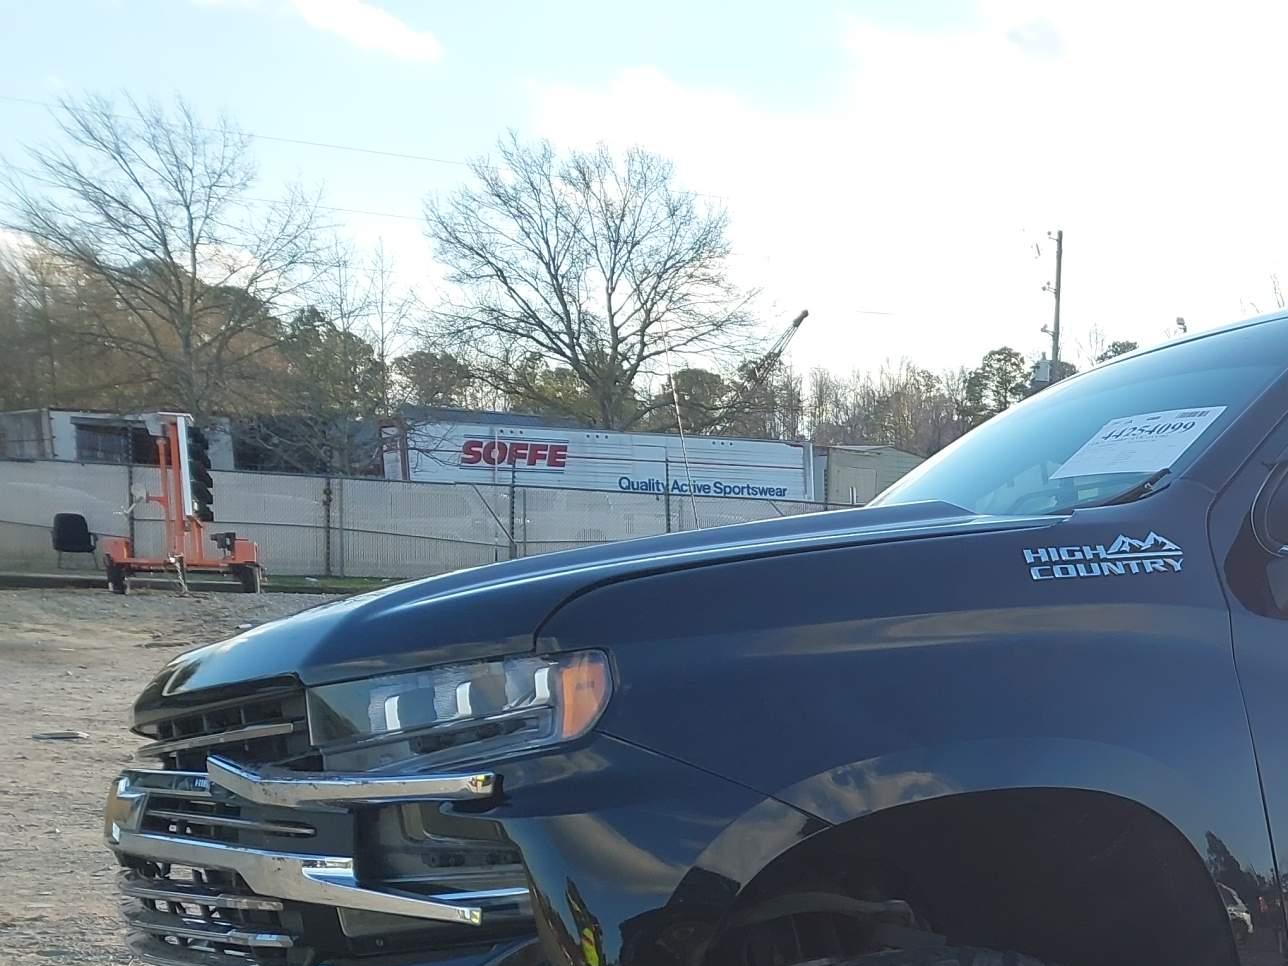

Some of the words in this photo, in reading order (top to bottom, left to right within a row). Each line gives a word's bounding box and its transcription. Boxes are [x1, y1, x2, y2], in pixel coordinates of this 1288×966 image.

[1101, 420, 1196, 440] 44254099
[460, 440, 569, 467] SOFFE
[713, 481, 788, 498] Sportswear
[1023, 545, 1109, 564] HIGH
[1030, 558, 1184, 581] COUNTRY
